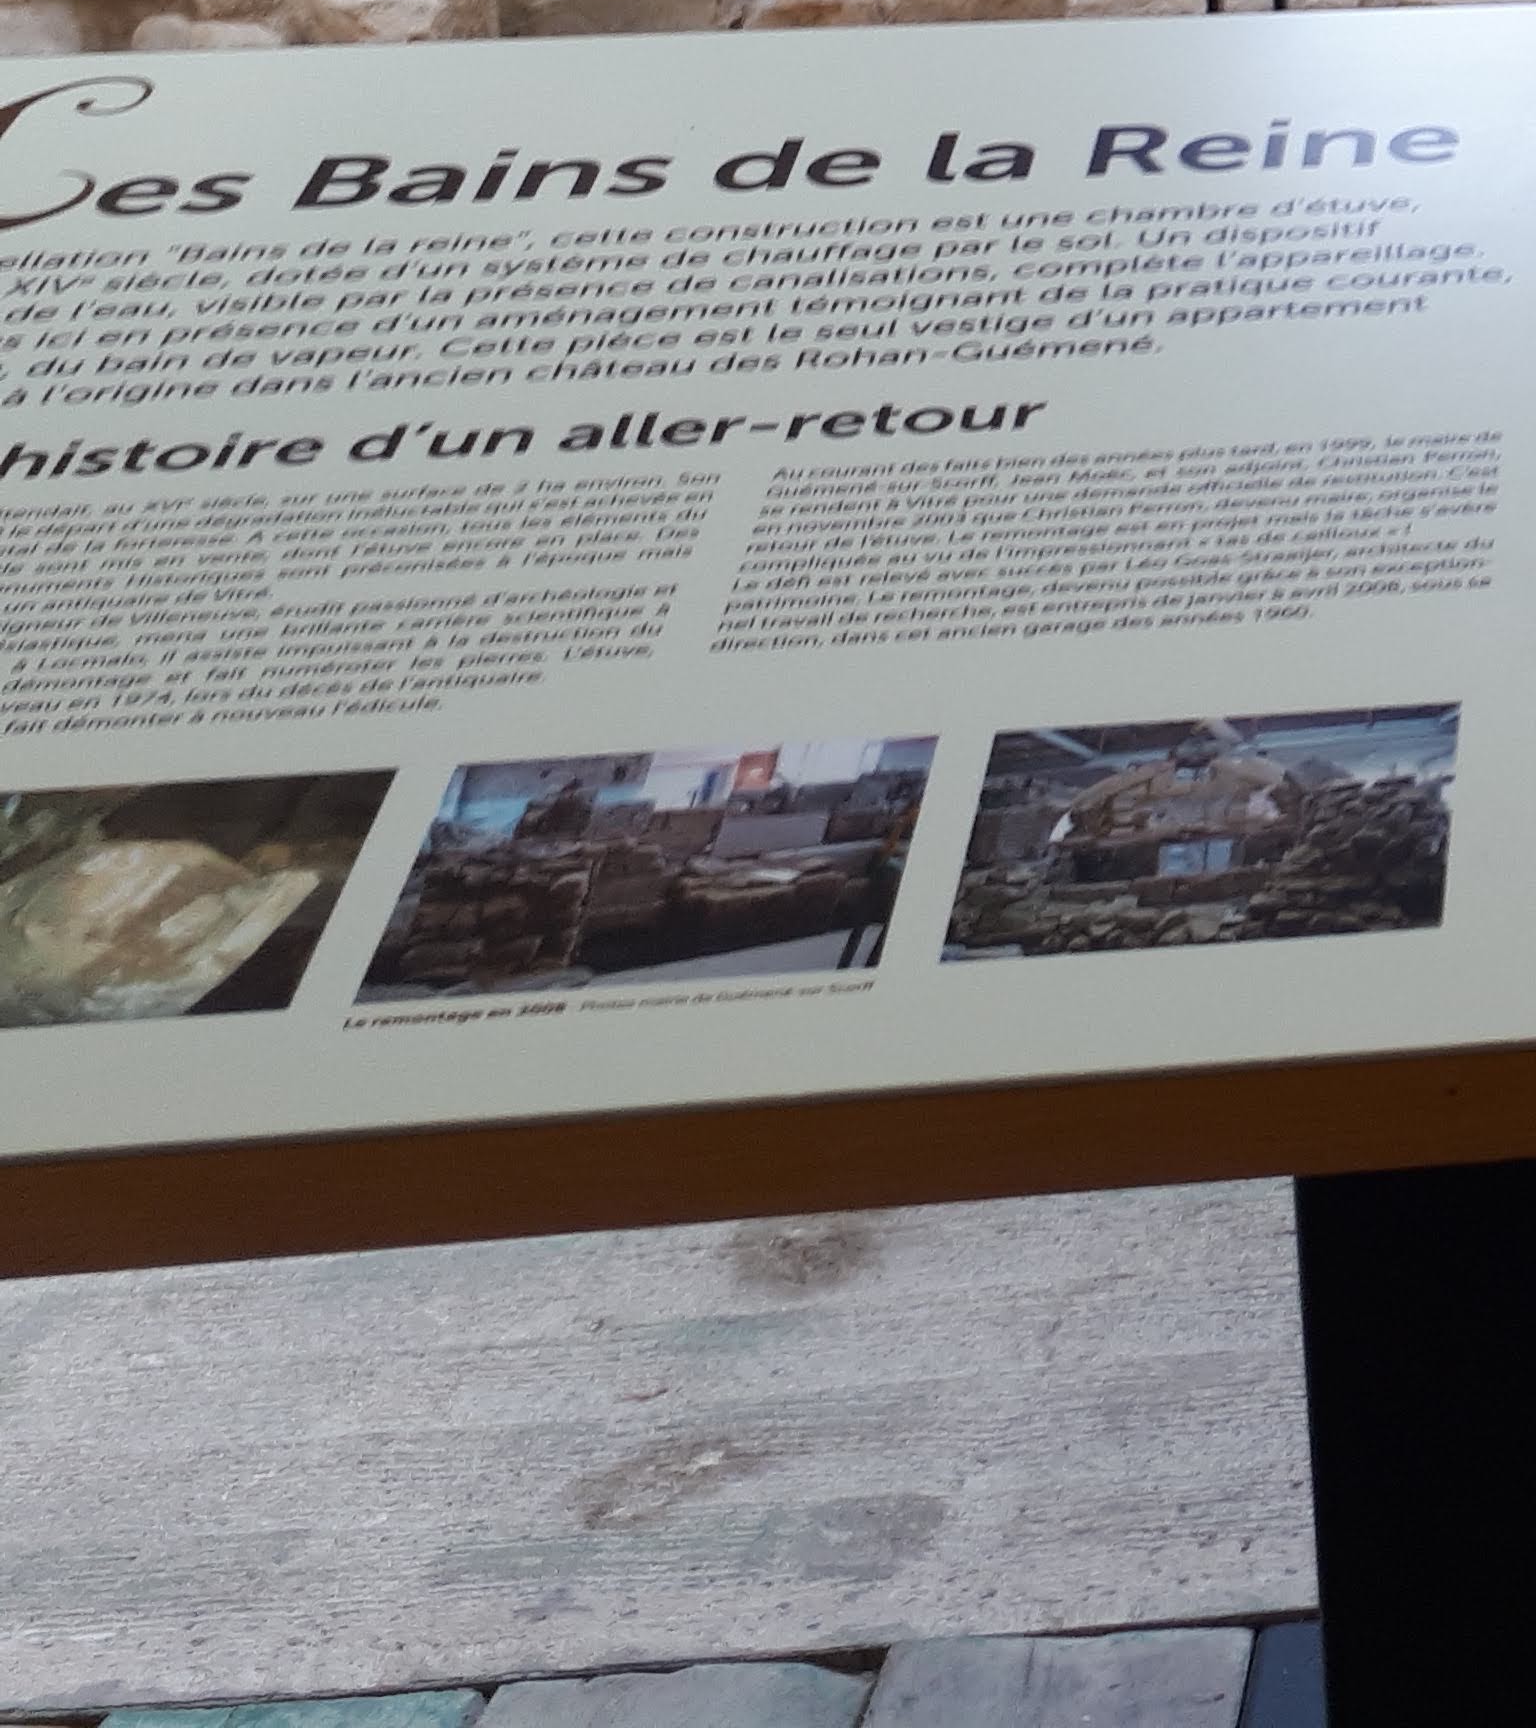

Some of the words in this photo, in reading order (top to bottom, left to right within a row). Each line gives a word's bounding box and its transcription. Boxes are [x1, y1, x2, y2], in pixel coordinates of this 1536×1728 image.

[290, 147, 674, 213] Bains
[713, 136, 882, 192] de
[927, 129, 1035, 184] la
[1084, 118, 1462, 178] Reine
[4, 275, 94, 296] XIVe
[103, 270, 226, 292] siècle,
[246, 265, 367, 285] dotée
[379, 260, 468, 280] d'un
[483, 255, 647, 277] système
[660, 249, 709, 268] de
[723, 243, 920, 264] chauffage
[932, 240, 995, 261] par
[1010, 235, 1043, 253] le
[1057, 231, 1118, 251] sol.
[1137, 228, 1190, 247] Un
[1203, 220, 1378, 245] dispositif
[169, 244, 285, 263] "Bains
[299, 238, 350, 257] de
[363, 237, 396, 254] la
[409, 231, 531, 252] reine",
[550, 228, 652, 245] cette
[665, 218, 917, 241] construction
[931, 213, 984, 230] est
[1000, 213, 1072, 228] une
[1086, 204, 1257, 224] chambre
[1270, 197, 1417, 217] d'étuve,
[4, 303, 58, 322] de
[70, 300, 173, 320] l'eau,
[196, 292, 324, 314] visible
[334, 292, 402, 312] par
[418, 285, 452, 303] la
[463, 281, 652, 306] présence
[666, 274, 716, 293] de
[730, 265, 994, 289] canalisations,
[1014, 255, 1202, 278] complète
[34, 330, 86, 349] ici
[95, 329, 150, 345] en
[160, 320, 358, 346] présence
[372, 313, 464, 332] d'un
[476, 300, 772, 327] aménagement
[791, 289, 1021, 313] témoignant
[1038, 284, 1087, 303] de
[1101, 276, 1133, 300] la
[1146, 277, 1312, 302] pratique
[1326, 261, 1510, 290] courante,
[26, 356, 84, 376] du
[96, 346, 188, 372] bain
[202, 348, 256, 368] de
[271, 345, 415, 367] vapeur.
[439, 336, 554, 354] Cette
[566, 331, 680, 355] pièce
[693, 326, 751, 344] est
[767, 323, 802, 342] le
[816, 319, 896, 339] seul
[912, 311, 1052, 335] vestige
[1067, 300, 1153, 328] d'un
[1168, 297, 1422, 326] appartement
[1, 387, 28, 406] à
[41, 382, 217, 404] l'origine
[231, 375, 332, 394] dans
[348, 366, 511, 388] l'ancien
[526, 359, 695, 380] château
[709, 352, 779, 372] des
[0, 430, 325, 481] histoire
[348, 421, 535, 465] d'un
[556, 398, 1049, 456] aller-retour
